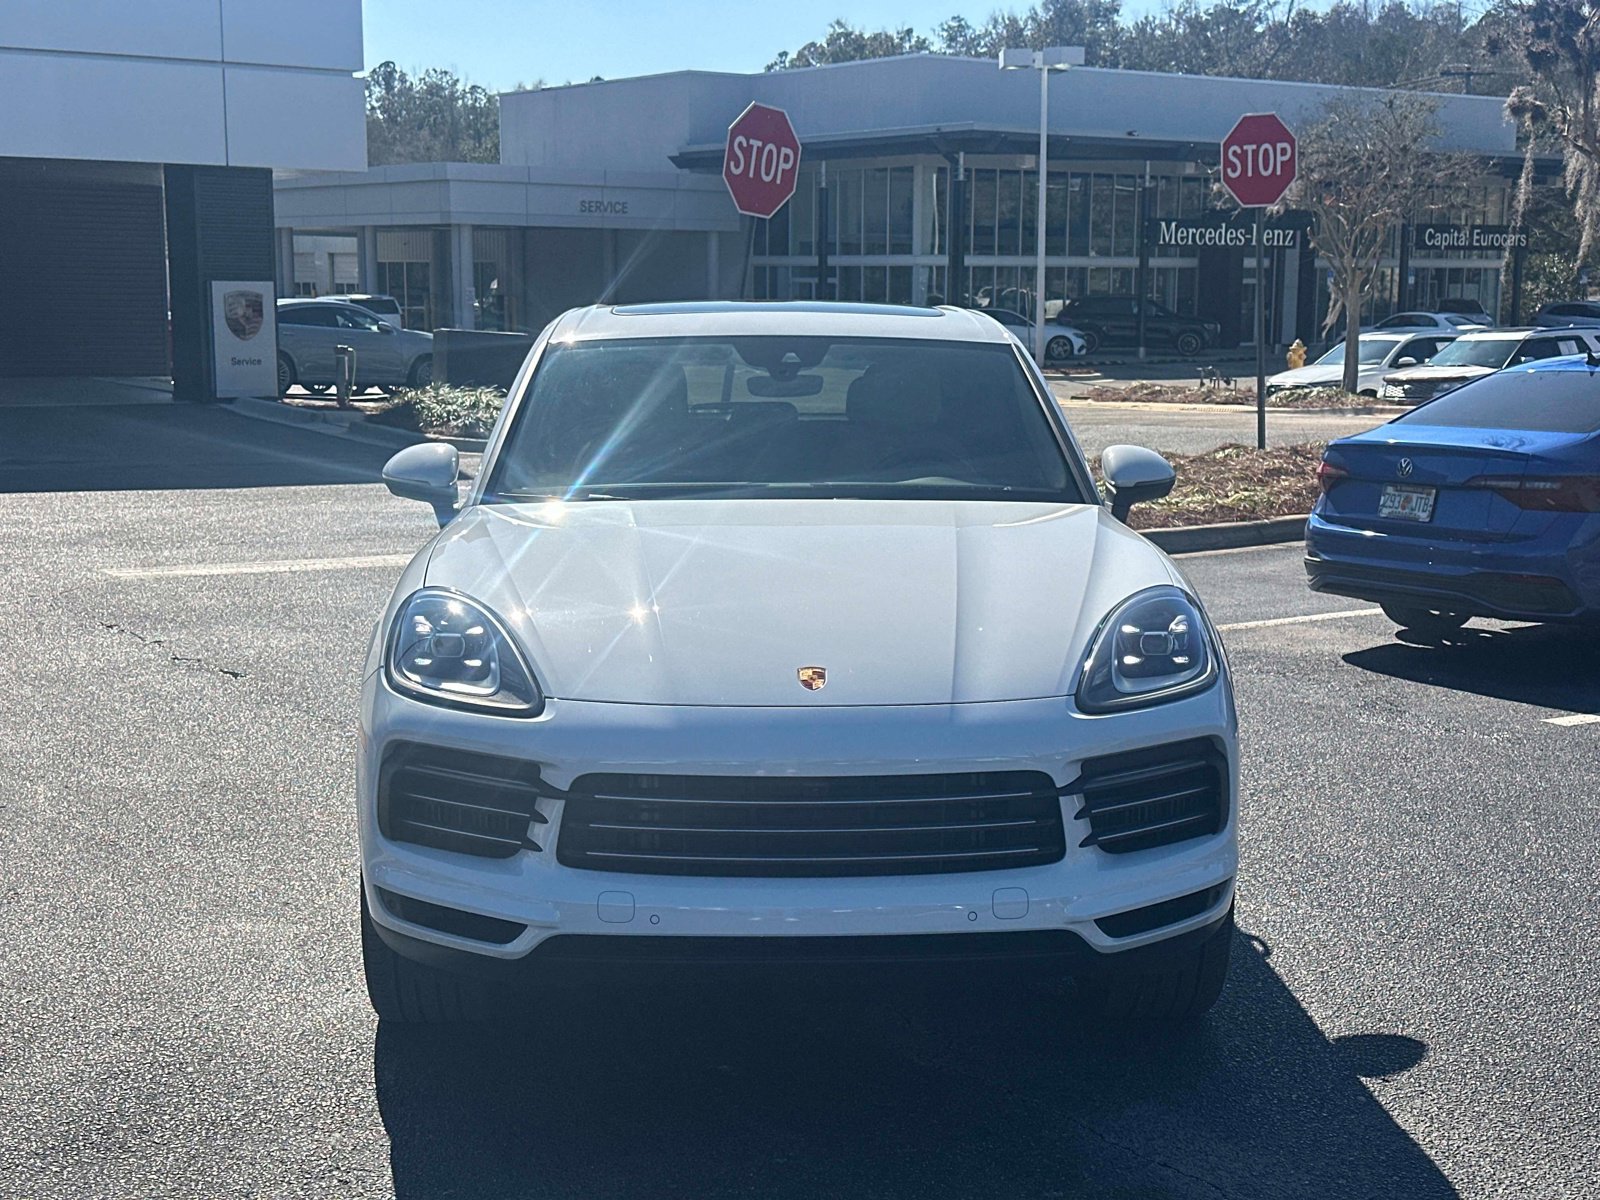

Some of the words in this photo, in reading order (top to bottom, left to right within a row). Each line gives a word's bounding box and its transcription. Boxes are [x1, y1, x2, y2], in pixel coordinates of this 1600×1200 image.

[730, 135, 795, 185] STOP
[1226, 142, 1292, 178] STOP
[580, 200, 629, 214] SERVICE
[1425, 228, 1470, 250] Capital
[1473, 229, 1527, 247] Eurocars
[231, 357, 262, 366] Service
